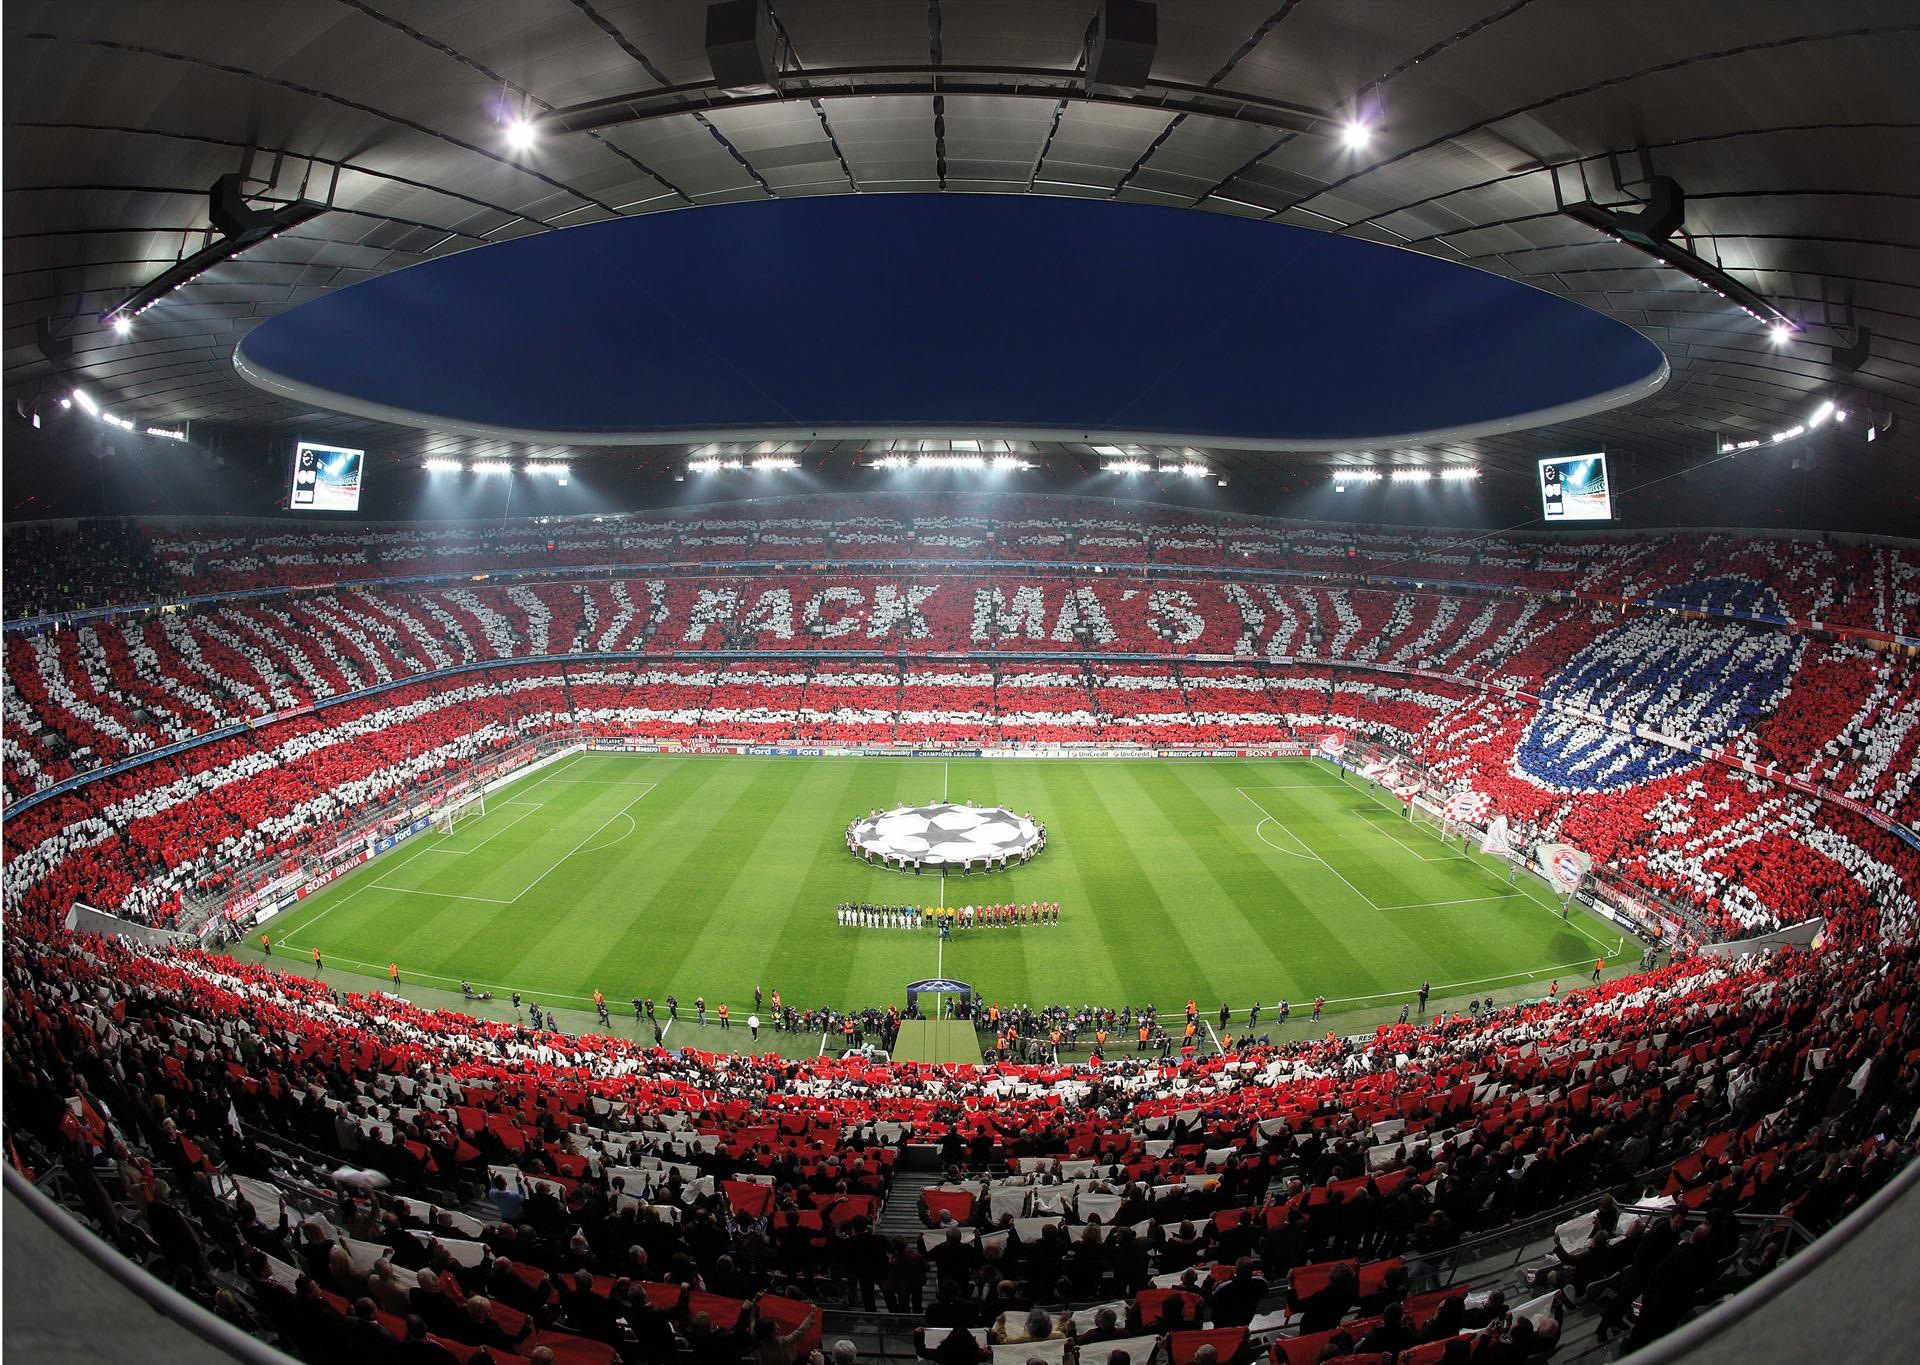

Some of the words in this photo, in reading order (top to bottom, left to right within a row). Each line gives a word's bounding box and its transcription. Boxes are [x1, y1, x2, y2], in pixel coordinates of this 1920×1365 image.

[683, 585, 940, 643] PACK
[796, 748, 819, 756] Ford
[880, 749, 911, 757] Responsibly
[1342, 762, 1355, 772] Ford
[394, 827, 411, 842] Ford
[305, 871, 333, 894] SONY
[336, 857, 362, 876] BRAVIA
